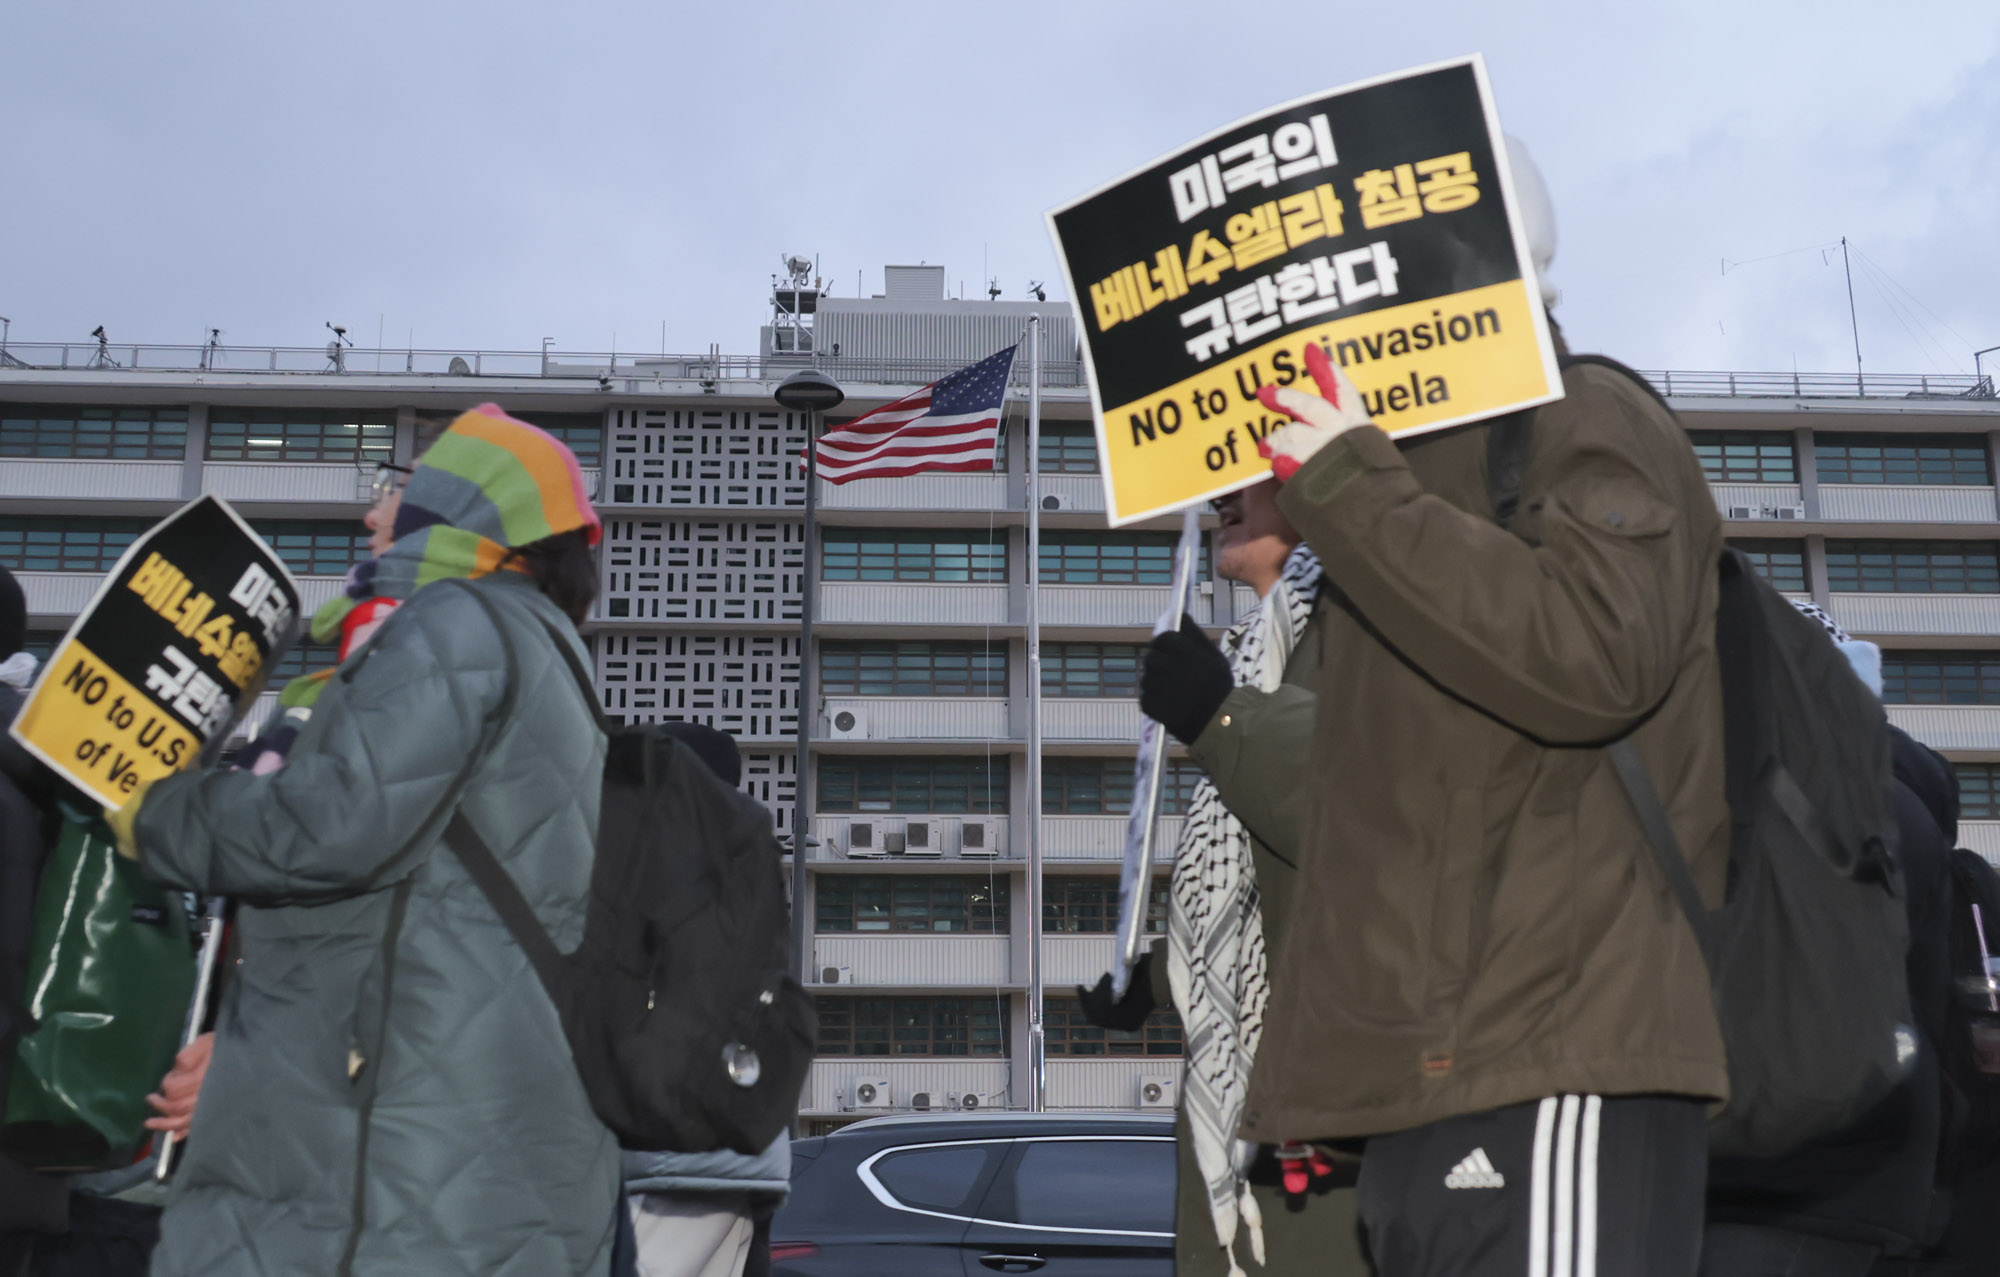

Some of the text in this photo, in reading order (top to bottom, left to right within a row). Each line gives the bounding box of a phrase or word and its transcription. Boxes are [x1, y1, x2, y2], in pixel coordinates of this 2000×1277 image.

[1168, 113, 1339, 224] 미국의
[1089, 151, 1481, 333] 베네수엘라 침공
[1180, 240, 1399, 362] 규탄한다
[1129, 305, 1502, 447] NO to US. invasion
[1206, 370, 1450, 472] of Vuela
[63, 659, 109, 706] NO
[105, 695, 135, 731] to
[76, 739, 112, 768] of
